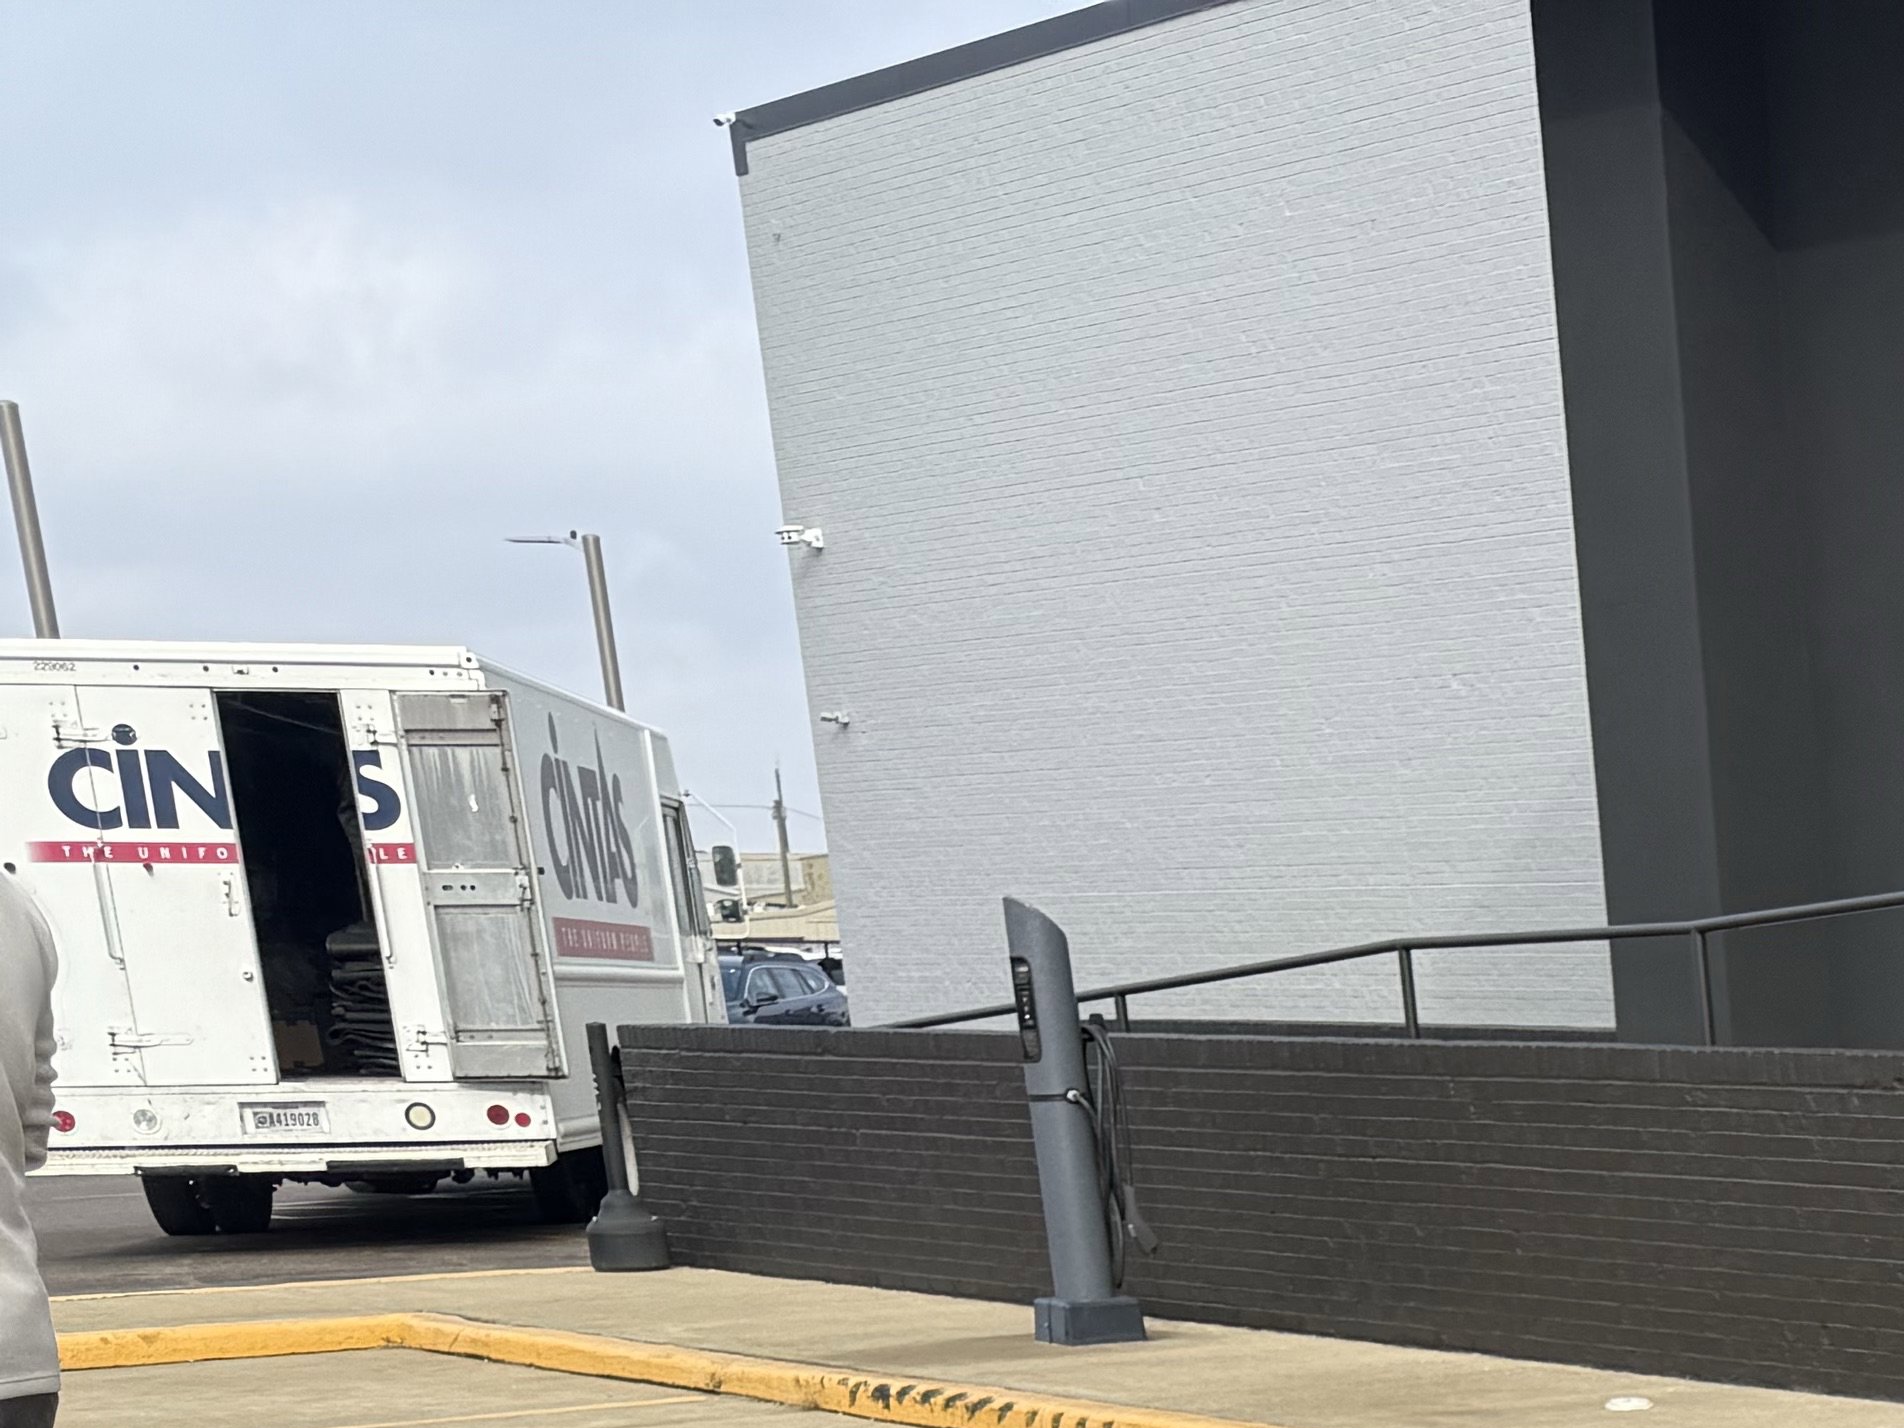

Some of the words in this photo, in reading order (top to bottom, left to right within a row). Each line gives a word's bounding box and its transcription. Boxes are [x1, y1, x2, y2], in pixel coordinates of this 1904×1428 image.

[48, 724, 401, 830] CINS
[62, 845, 114, 859] THE
[138, 846, 229, 860] UNIFO
